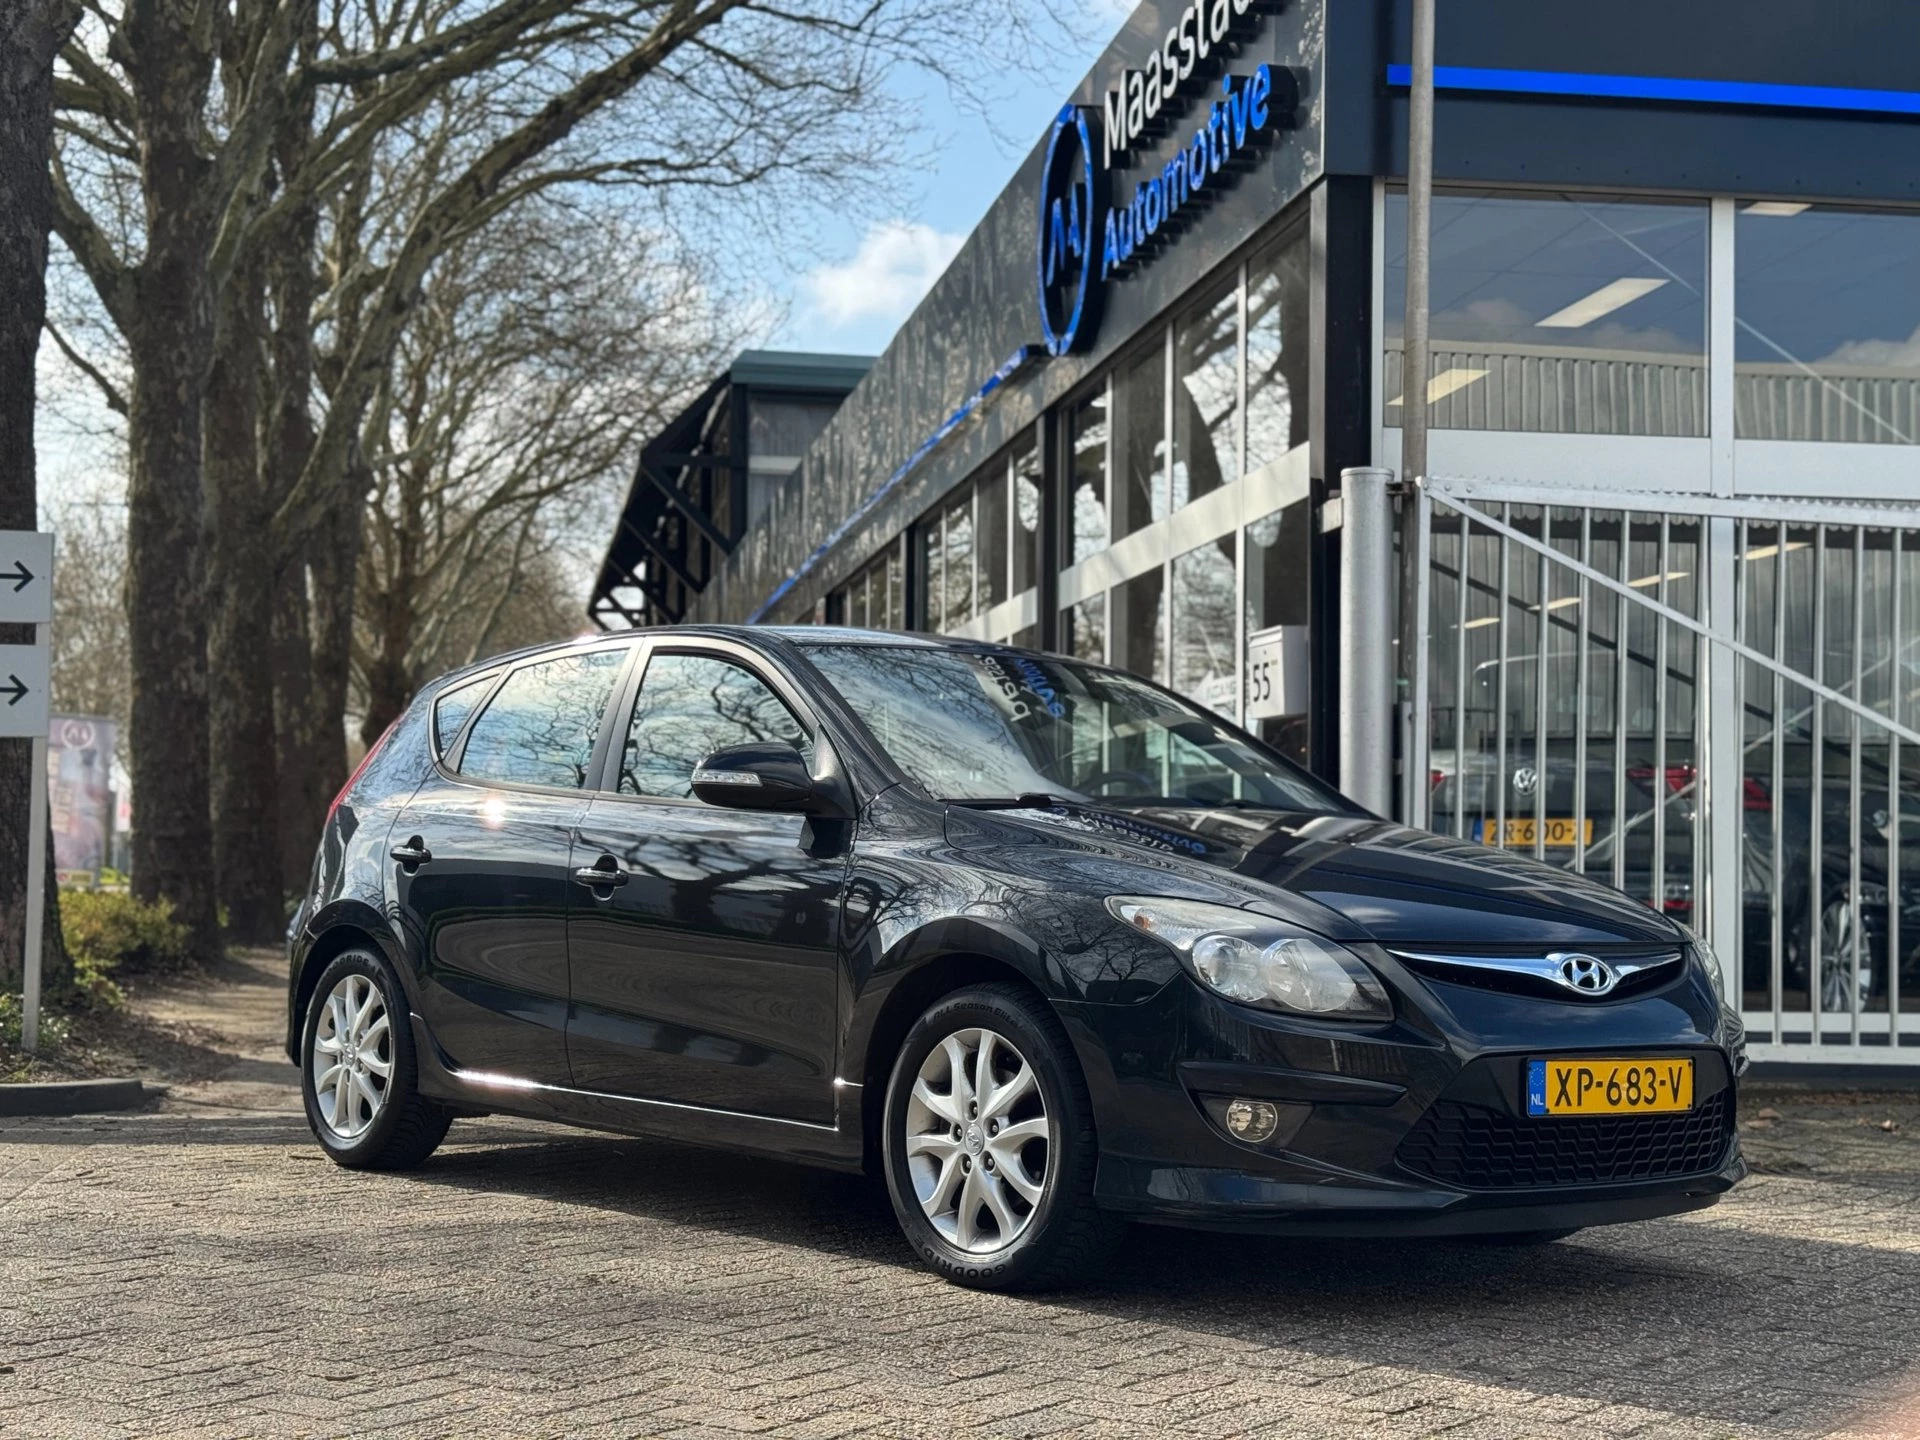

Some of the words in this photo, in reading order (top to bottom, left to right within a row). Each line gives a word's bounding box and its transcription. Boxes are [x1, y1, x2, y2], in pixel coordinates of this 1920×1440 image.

[1102, 63, 1271, 282] Automotive
[1252, 661, 1271, 702] 55
[953, 1002, 993, 1013] Season
[1530, 1092, 1544, 1106] NL
[1554, 1066, 1683, 1107] XP-683-V
[916, 1236, 1006, 1279] GOODRIDE
